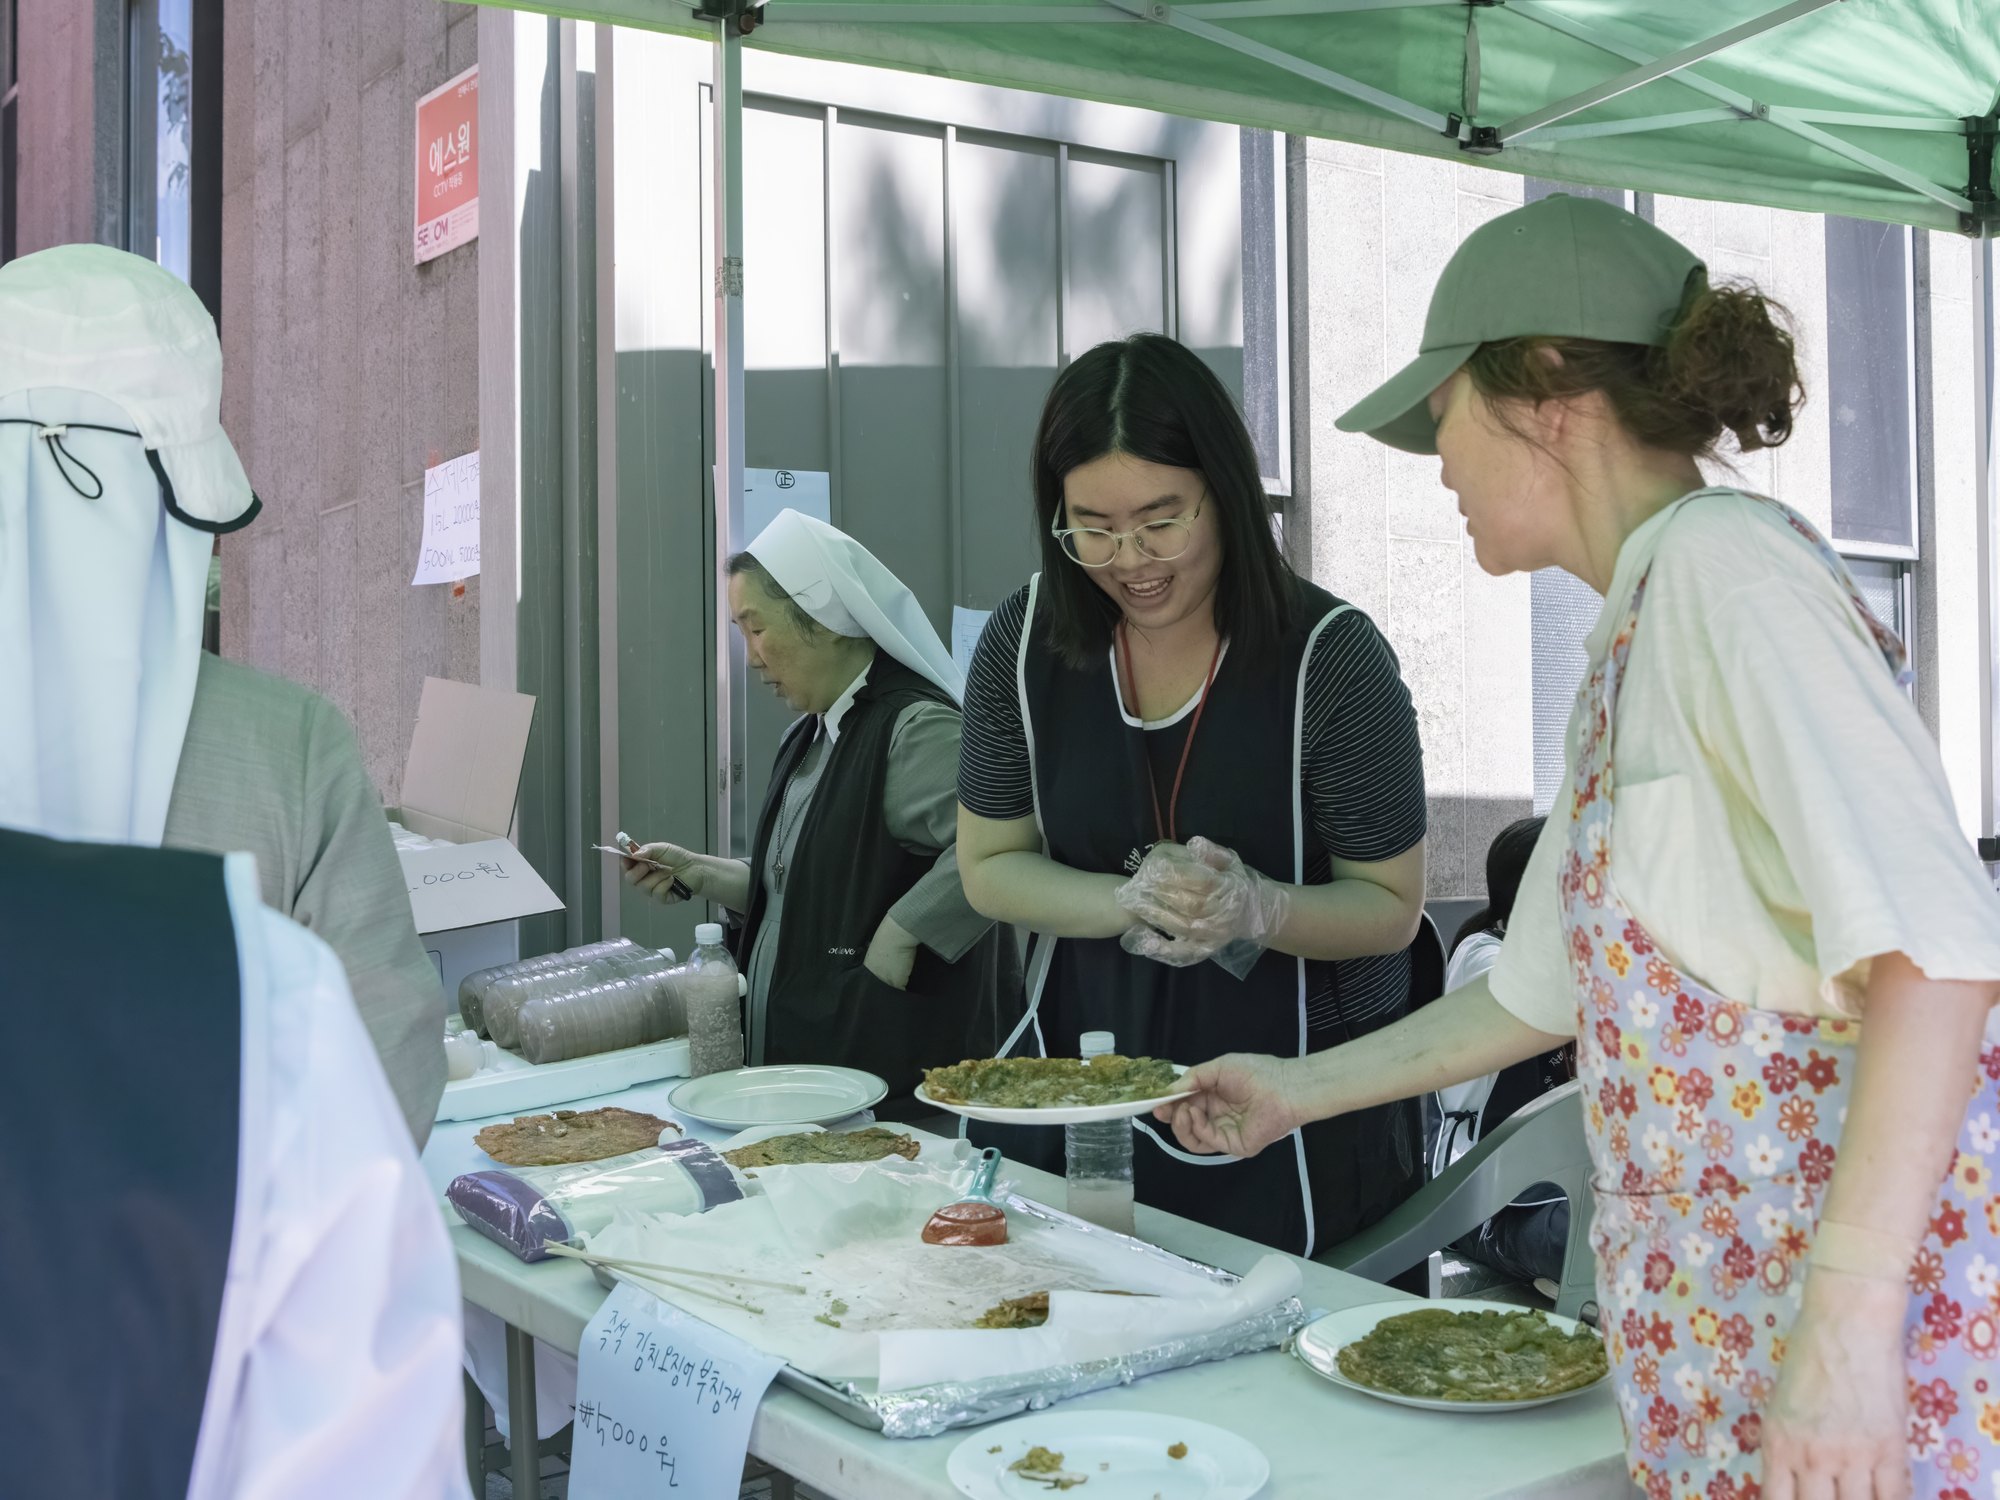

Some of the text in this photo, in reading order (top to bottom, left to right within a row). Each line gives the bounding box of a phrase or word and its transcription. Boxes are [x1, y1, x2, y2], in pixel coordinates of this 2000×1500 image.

[429, 121, 471, 176] 에스원
[433, 180, 449, 198] CCTV
[417, 217, 449, 249] SEOM
[599, 1310, 631, 1354] 즉석
